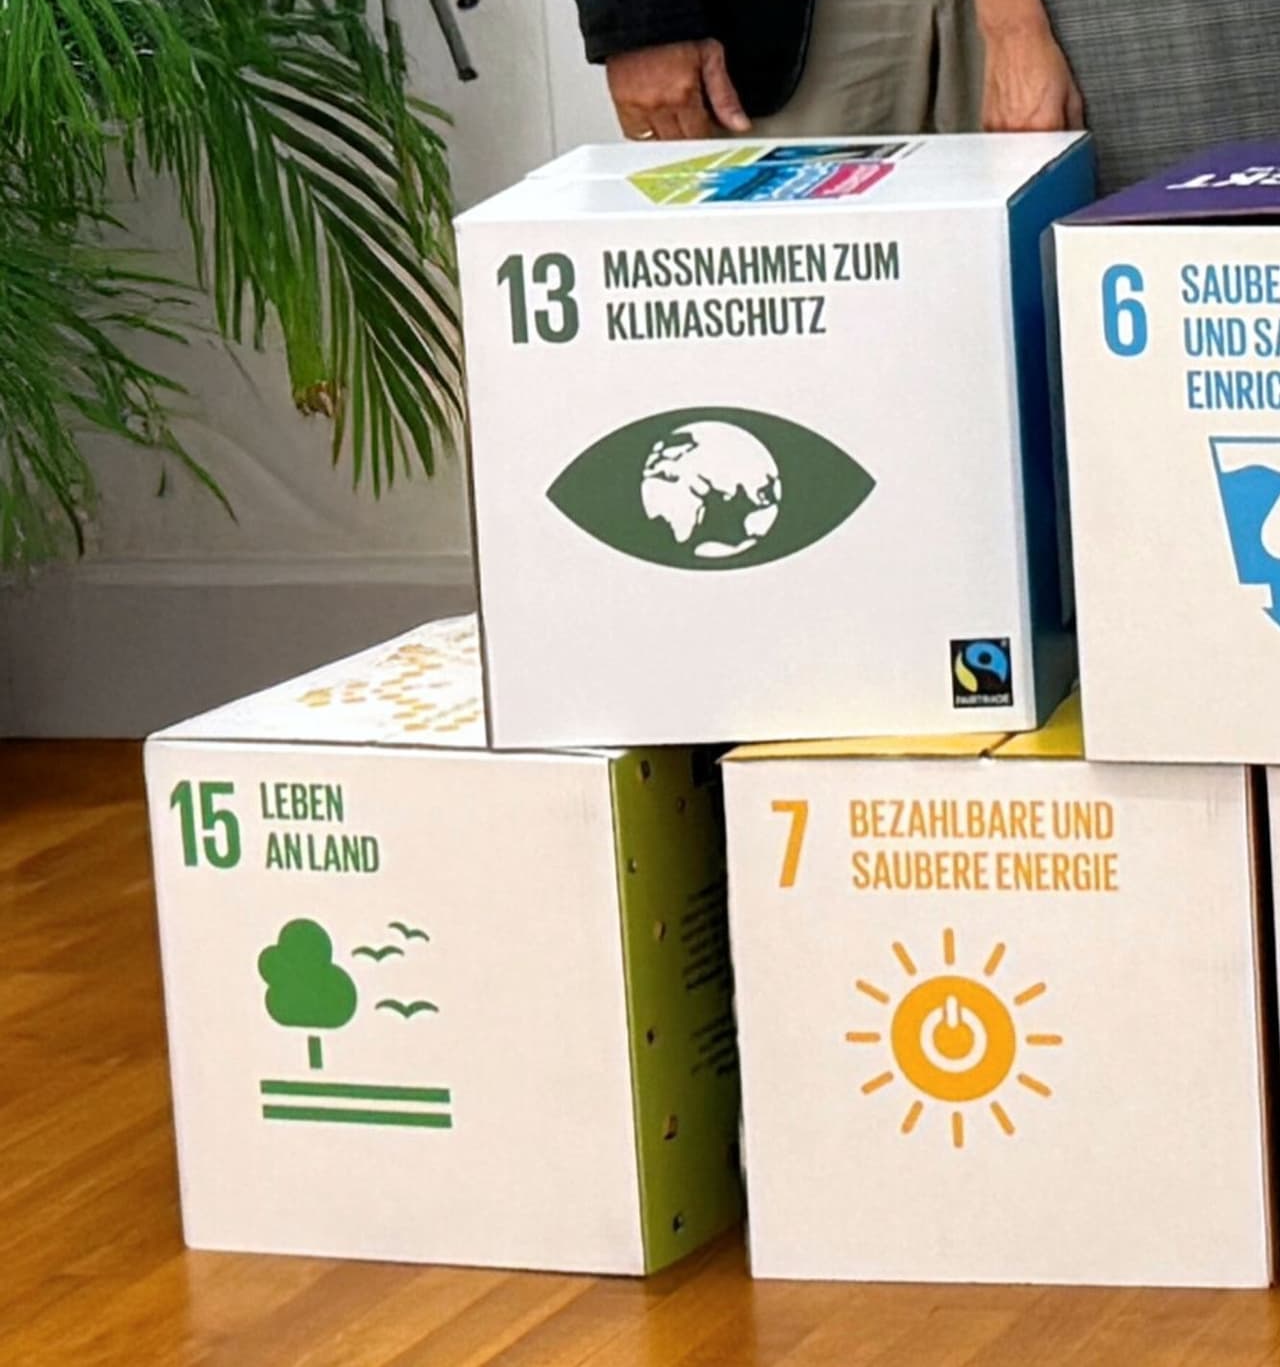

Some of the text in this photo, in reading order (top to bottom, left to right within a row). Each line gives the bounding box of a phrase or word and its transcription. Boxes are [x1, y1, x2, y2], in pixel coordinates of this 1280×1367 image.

[603, 241, 899, 288] MASSNAHMEN ZUM
[497, 253, 579, 344] 13
[607, 296, 826, 340] KLIMASCHUTZ
[1102, 264, 1148, 357] 6
[1184, 318, 1246, 356] UND
[260, 782, 343, 822] LEBEN
[850, 800, 1113, 840] BEZAHLBARE UND
[170, 780, 241, 869] 15
[771, 800, 808, 888] 7
[266, 832, 379, 872] AN LAND
[853, 851, 1117, 891] SAUBERE ENERGIE
